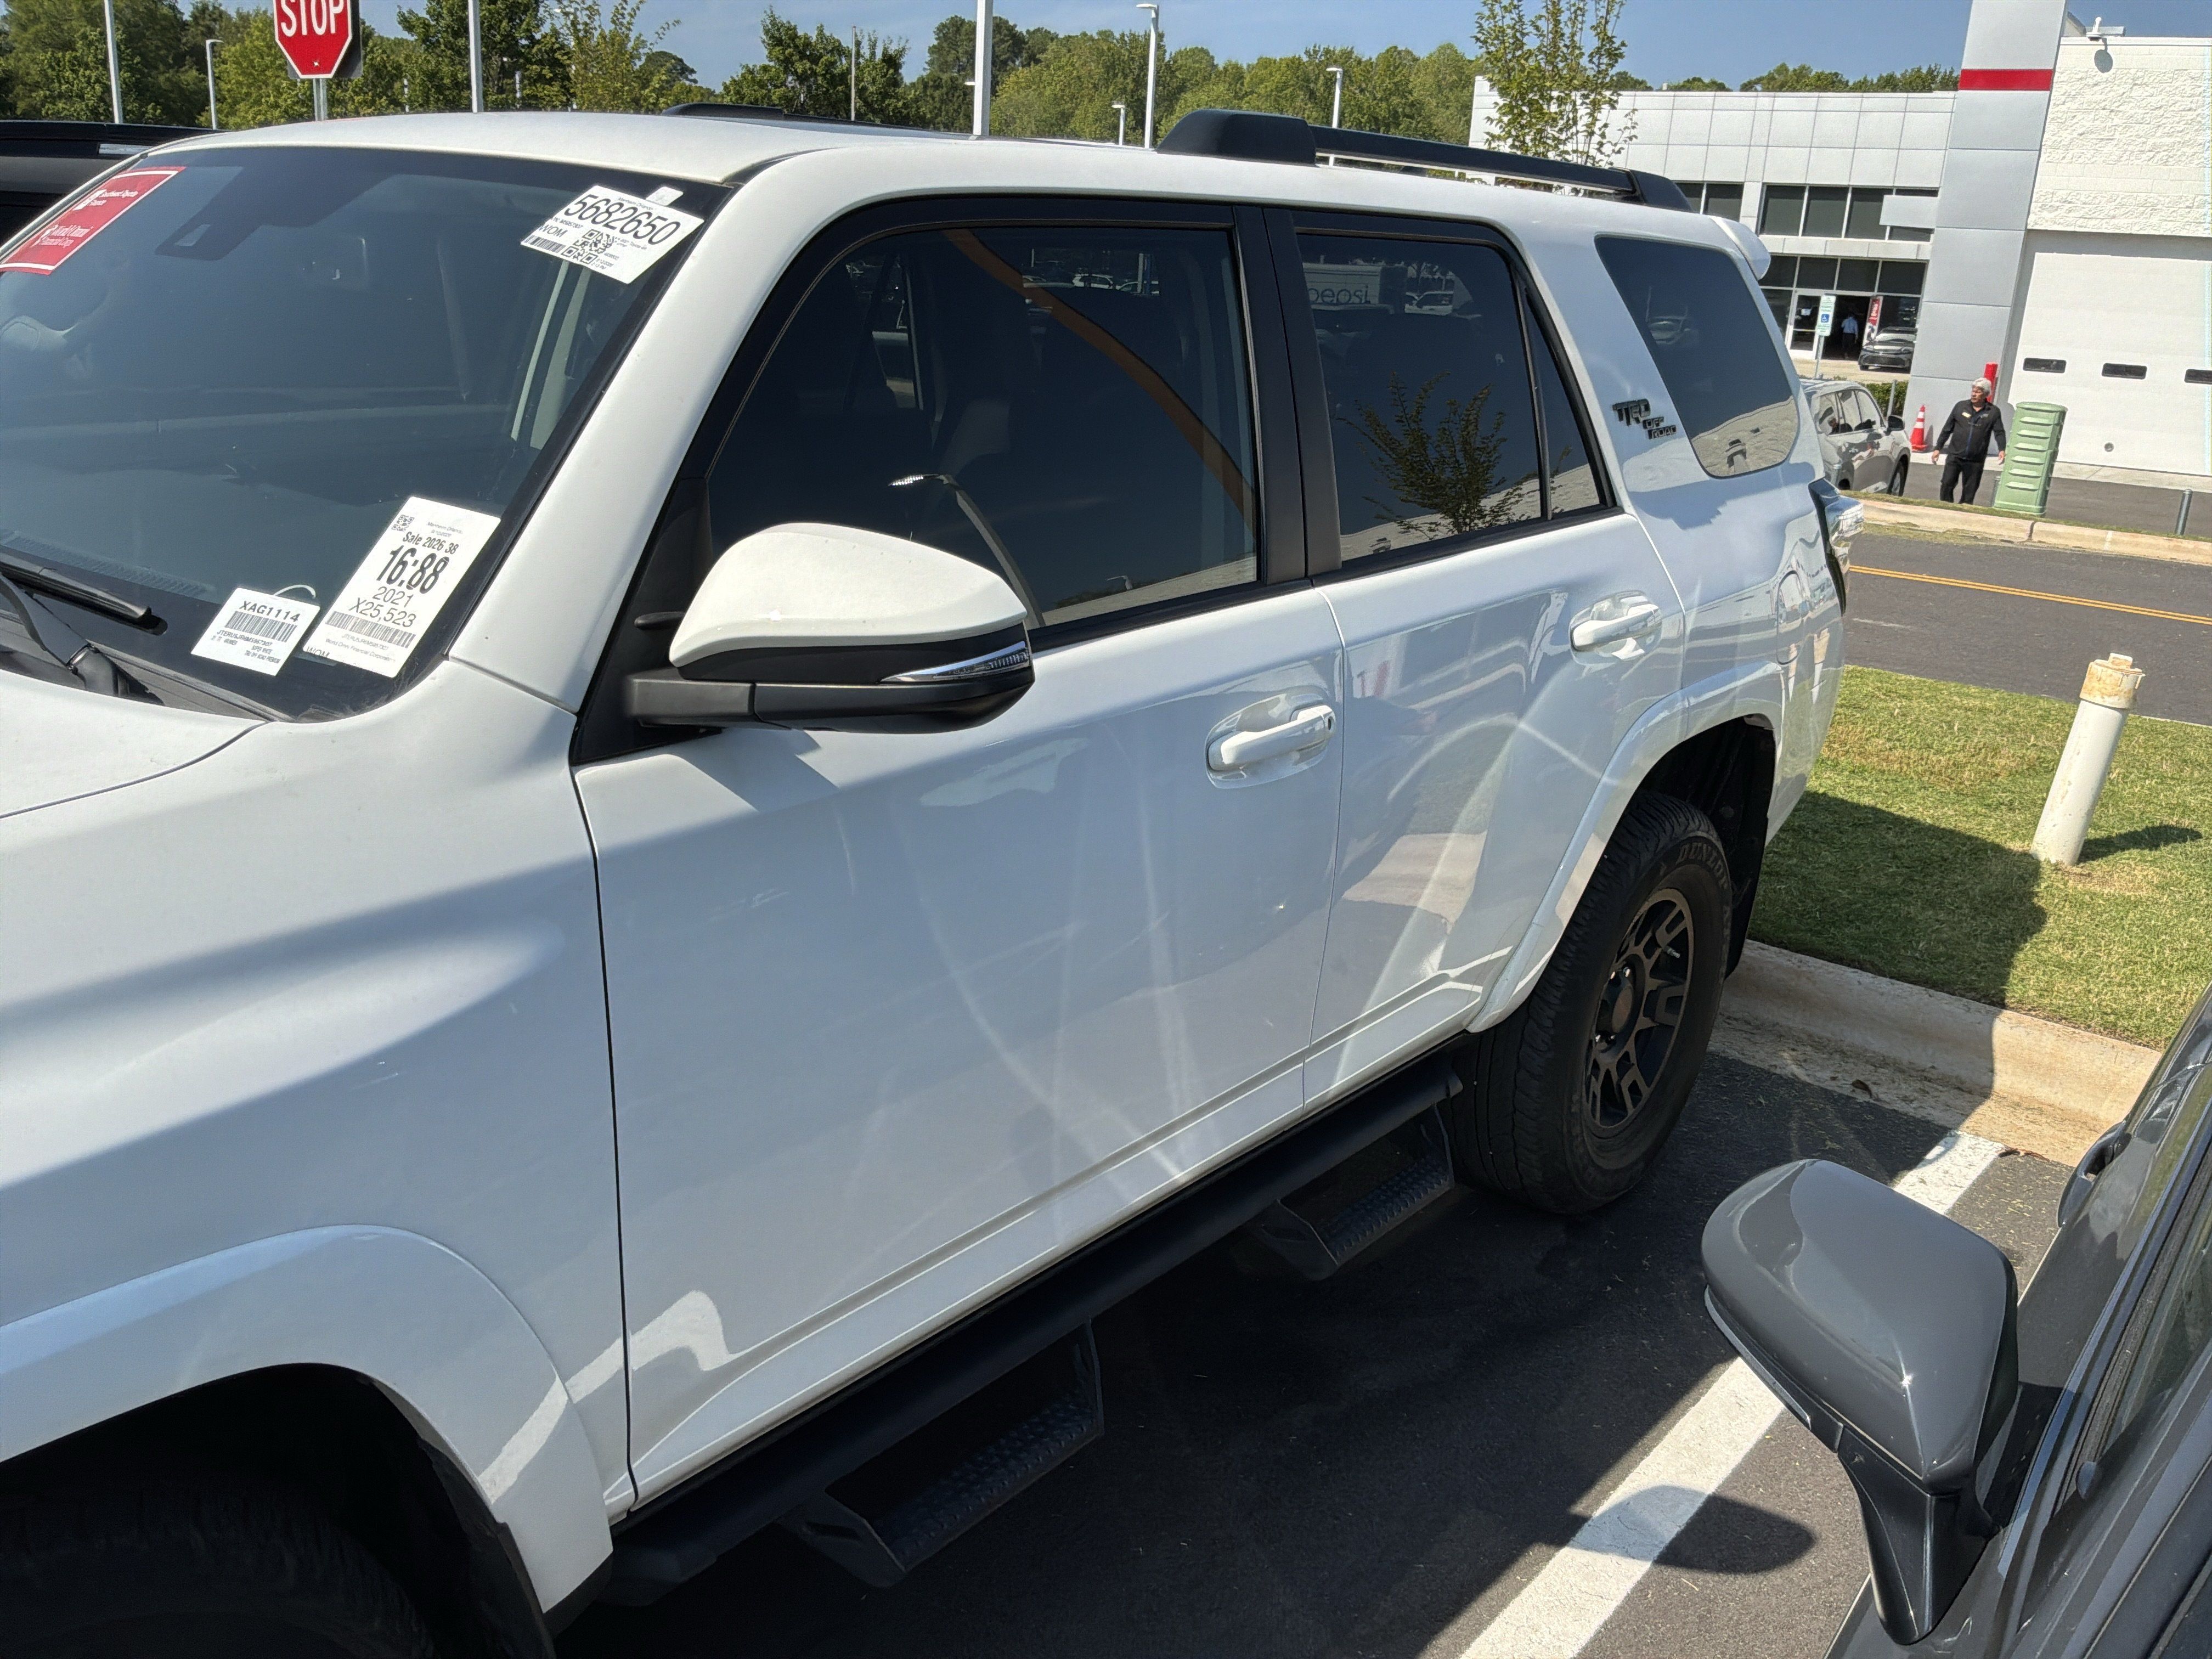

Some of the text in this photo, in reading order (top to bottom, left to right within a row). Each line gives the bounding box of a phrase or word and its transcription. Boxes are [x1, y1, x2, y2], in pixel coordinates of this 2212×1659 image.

[281, 0, 344, 37] STOP
[539, 224, 568, 237] WOM
[564, 194, 681, 245] 5682650
[1612, 399, 1650, 426] TRD
[1643, 417, 1664, 430] OFF
[1647, 425, 1677, 439] ROAD
[403, 532, 459, 554] Sale 2026 38
[376, 545, 449, 594] 16:88
[373, 586, 414, 607] 2021
[239, 601, 300, 622] XAG1114
[348, 597, 416, 627] X25,523
[351, 646, 370, 654] Financial
[1675, 842, 1729, 890] DUNLOP
